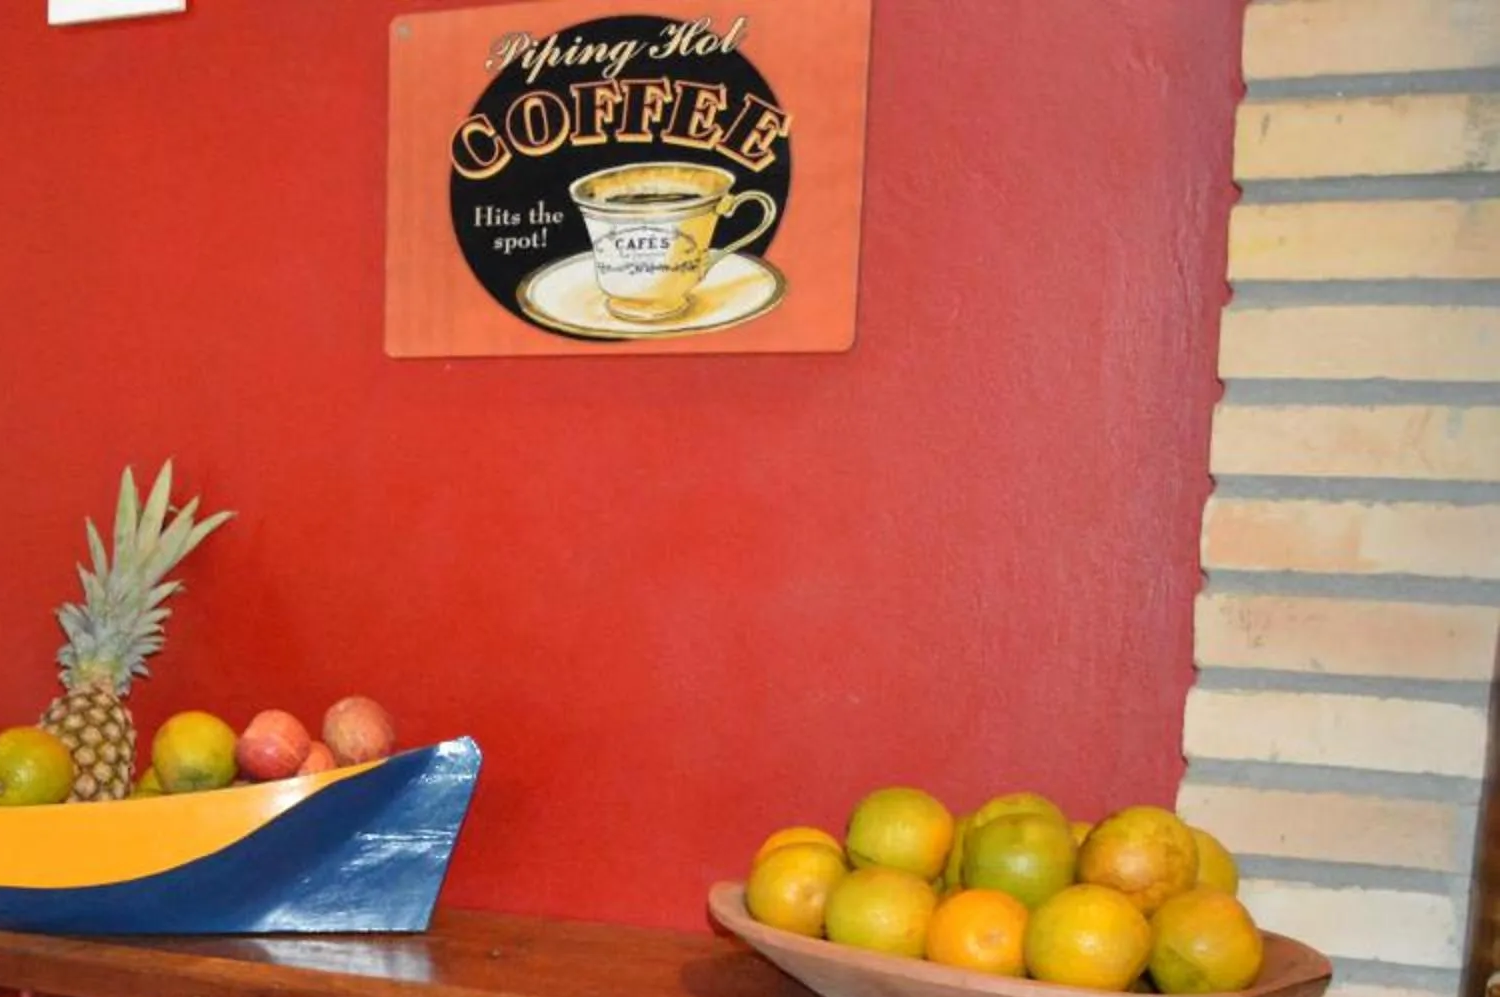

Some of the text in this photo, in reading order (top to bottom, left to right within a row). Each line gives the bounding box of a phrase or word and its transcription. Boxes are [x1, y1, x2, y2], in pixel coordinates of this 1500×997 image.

[484, 16, 747, 85] Piping Hot
[450, 77, 792, 180] COFFEE
[473, 200, 565, 228] Hits the
[492, 227, 549, 255] spot!
